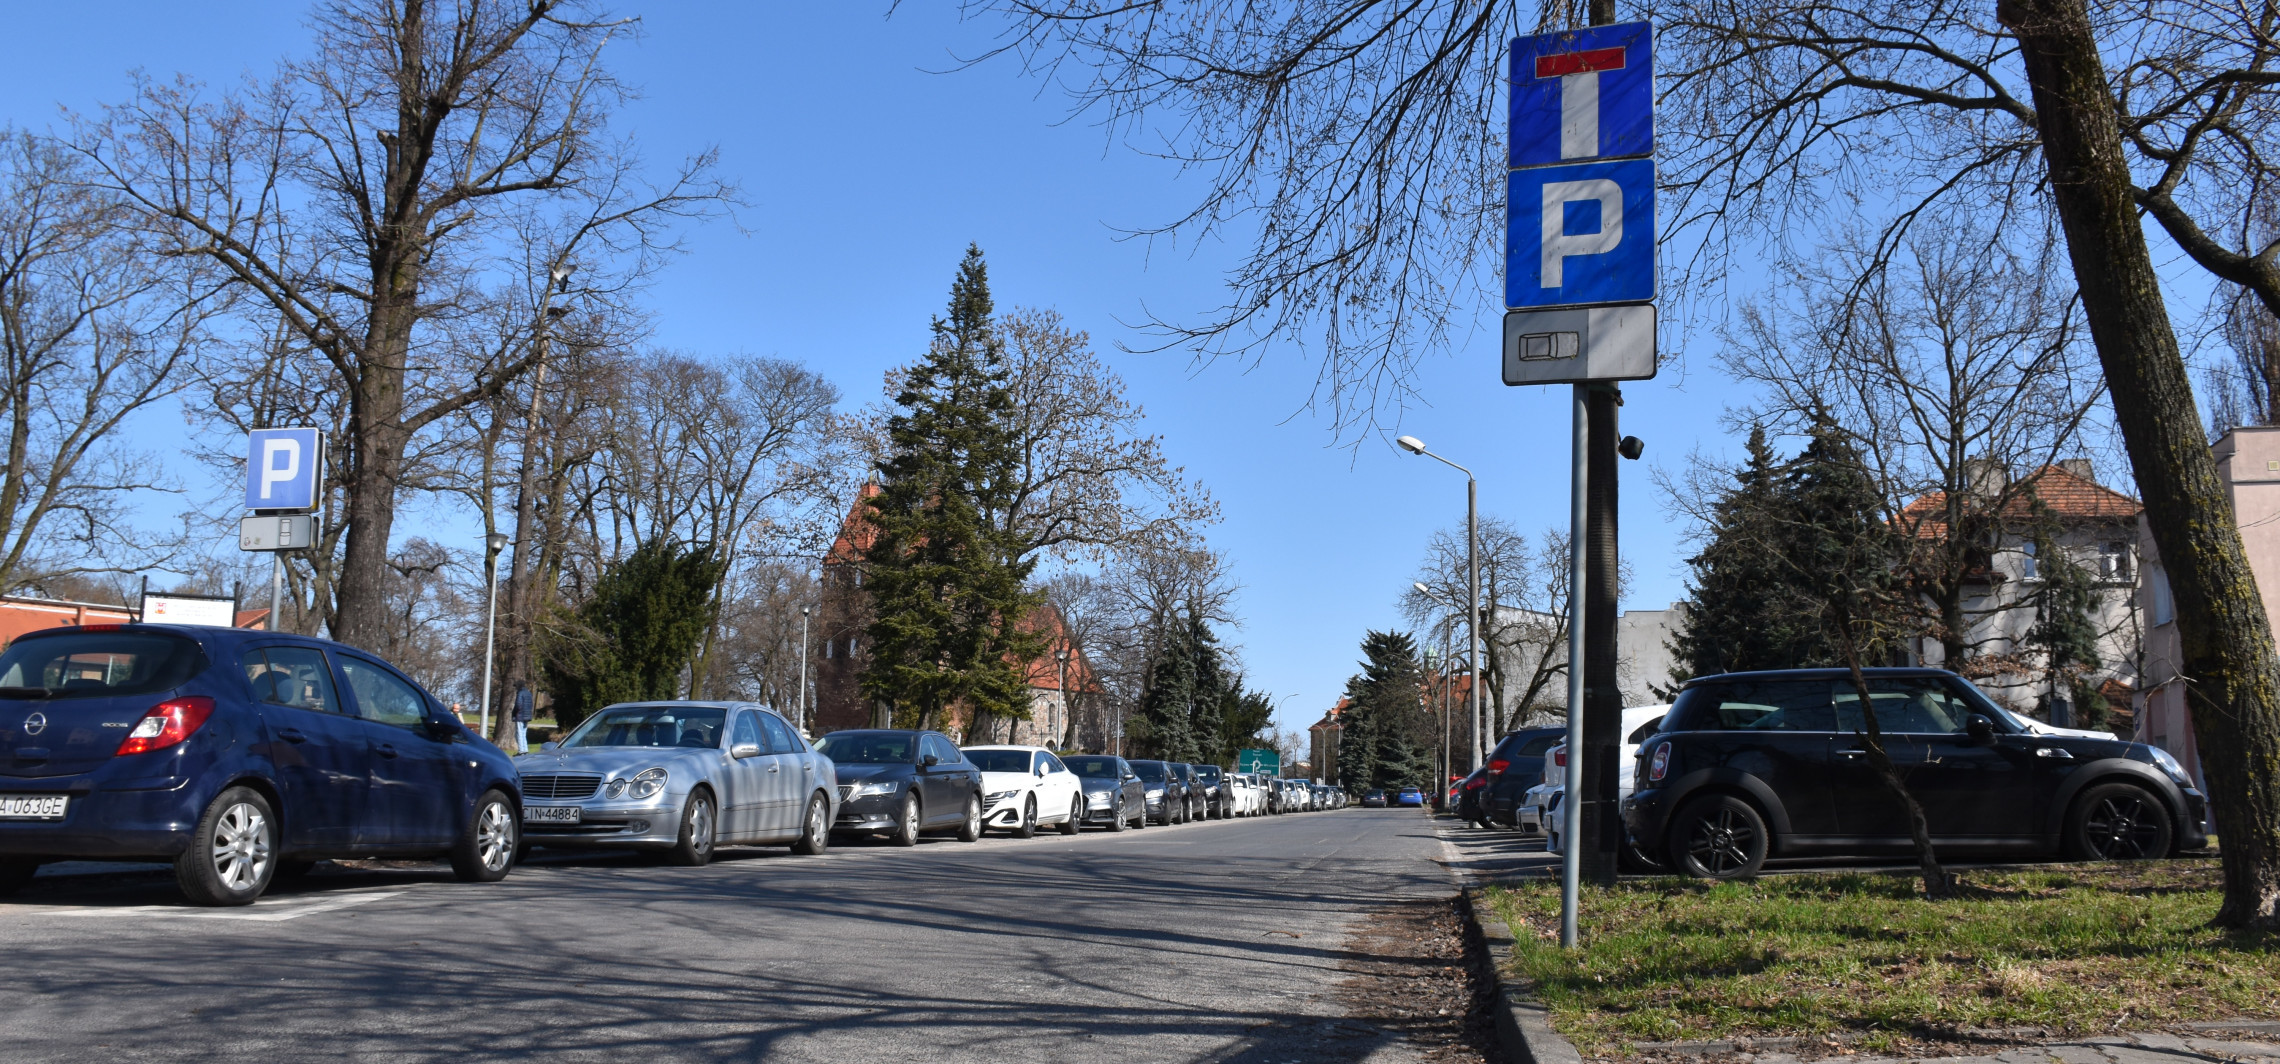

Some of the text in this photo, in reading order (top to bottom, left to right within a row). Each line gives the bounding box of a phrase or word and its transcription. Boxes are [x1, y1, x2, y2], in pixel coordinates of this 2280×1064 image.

[1541, 178, 1623, 289] P
[260, 438, 300, 499] P
[13, 796, 63, 814] 063GE
[545, 808, 578, 820] 44884
